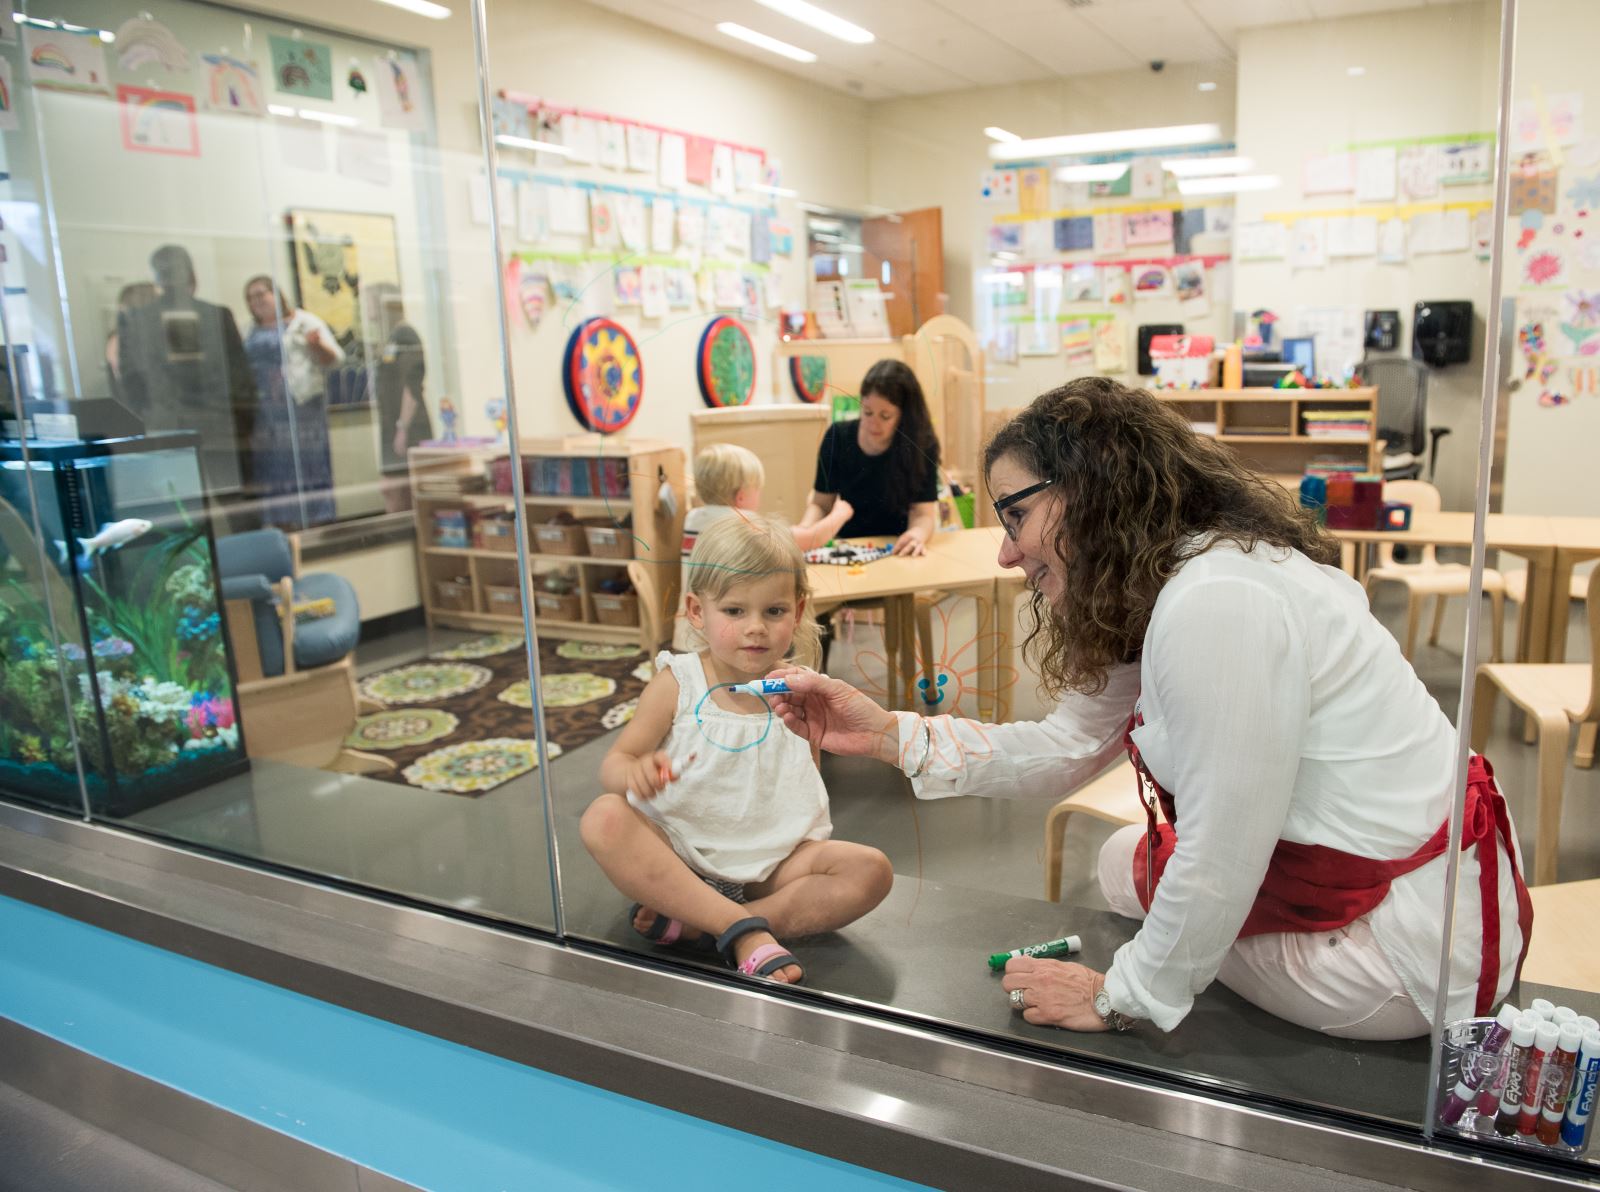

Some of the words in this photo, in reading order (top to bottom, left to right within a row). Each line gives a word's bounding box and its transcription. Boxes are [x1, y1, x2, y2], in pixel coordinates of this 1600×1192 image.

[765, 678, 784, 689] EXP
[1024, 944, 1048, 957] EXPO
[1506, 1073, 1522, 1103] EXPO
[1581, 1084, 1597, 1112] EXPO
